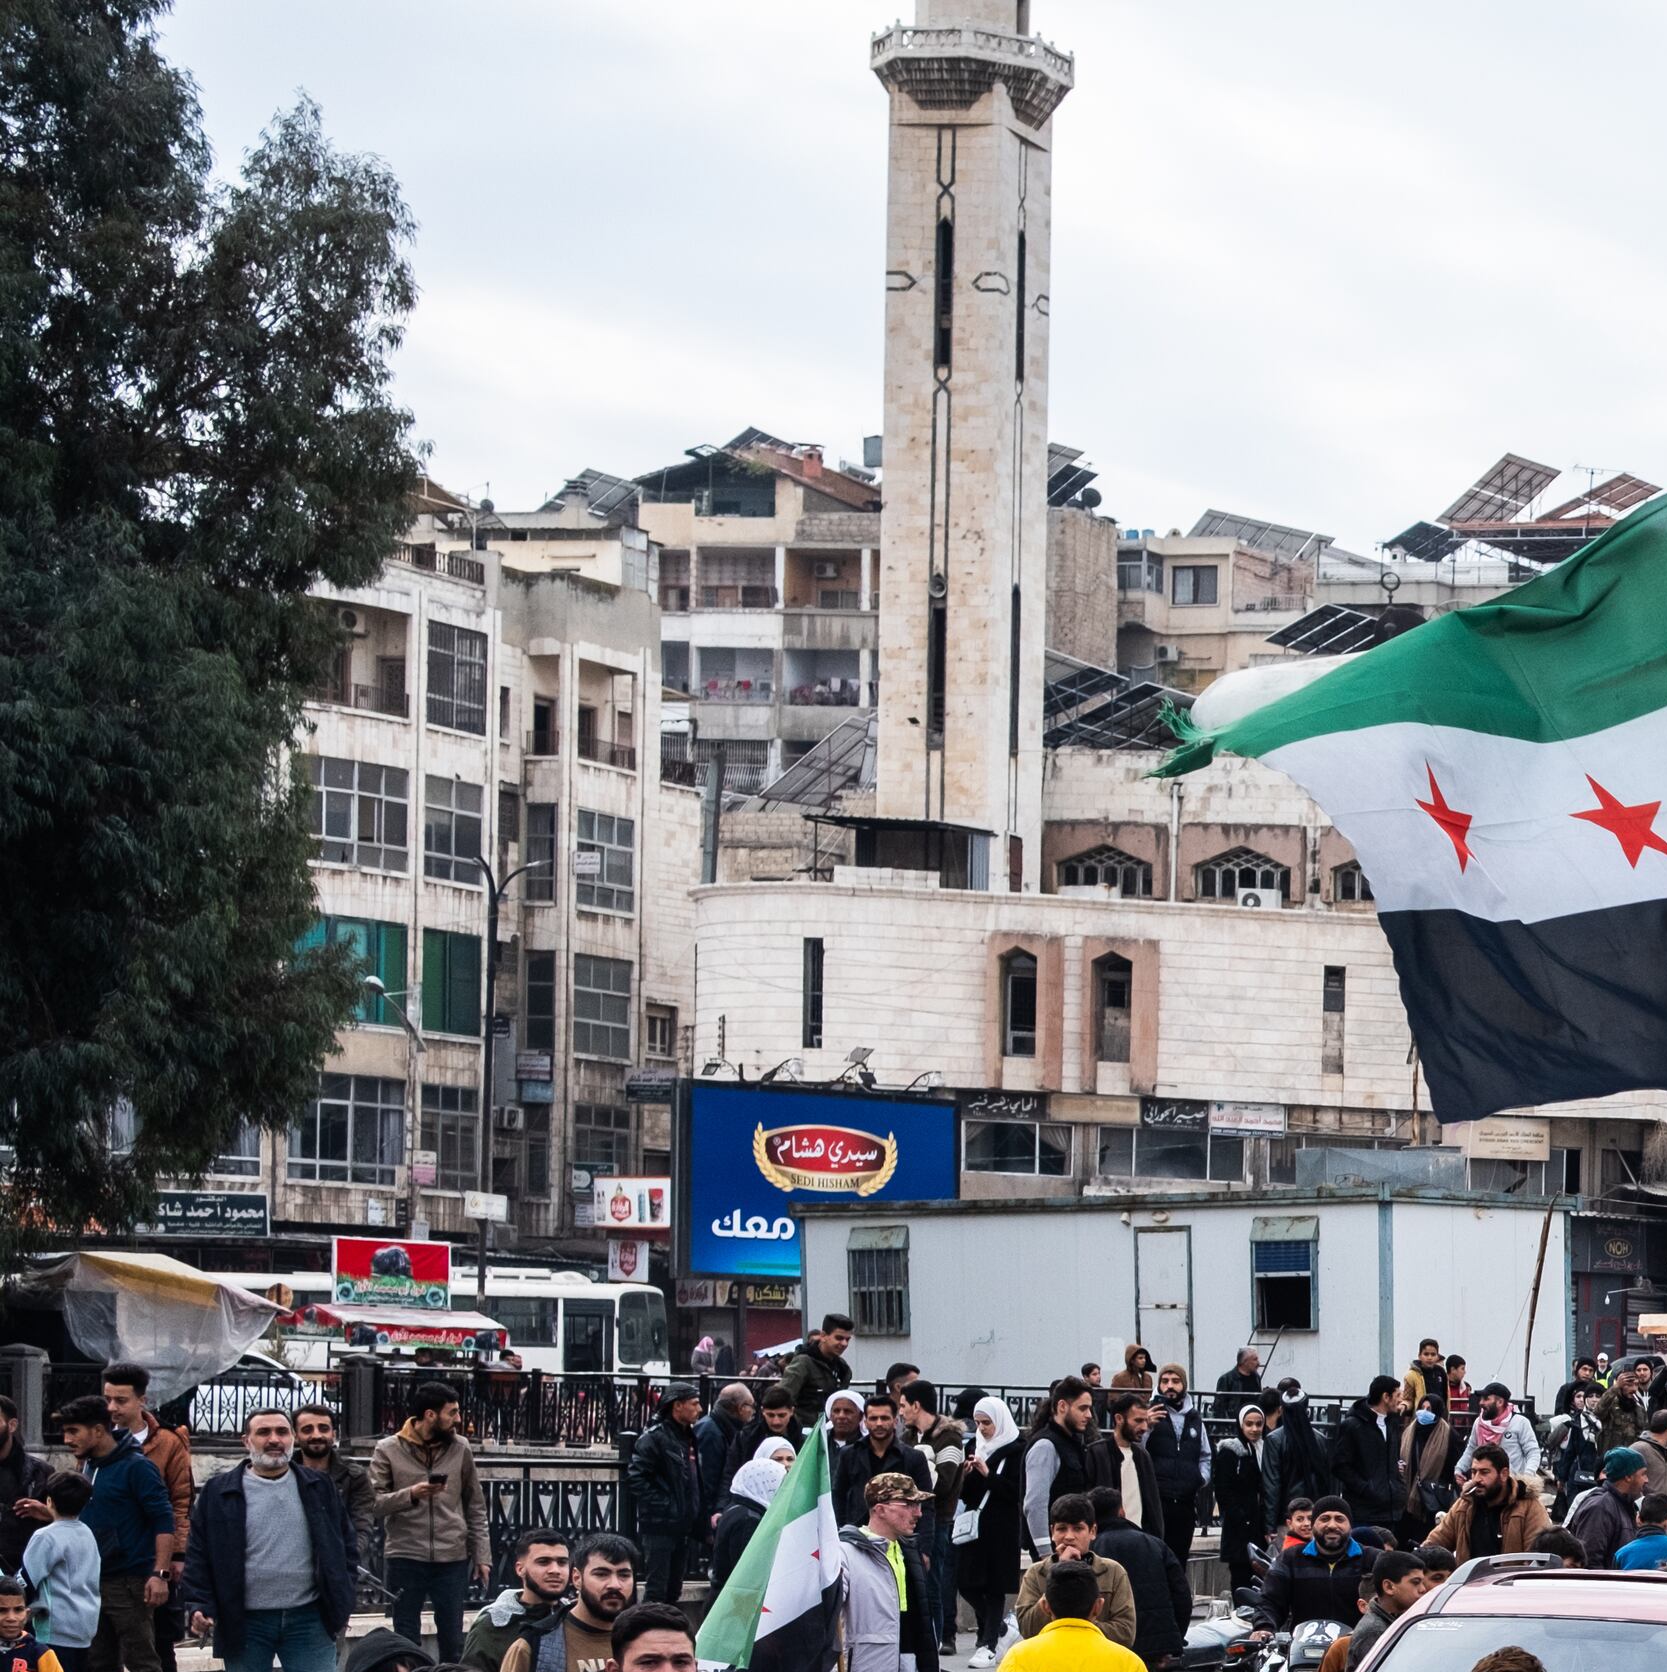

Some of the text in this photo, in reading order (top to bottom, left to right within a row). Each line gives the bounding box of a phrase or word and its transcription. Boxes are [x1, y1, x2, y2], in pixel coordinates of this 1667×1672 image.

[776, 1135, 878, 1169] سيدي هشام
[790, 1173, 861, 1189] SEDI HISHAM
[157, 1201, 264, 1221] محمود أحمد شاك
[711, 1208, 796, 1242] معك
